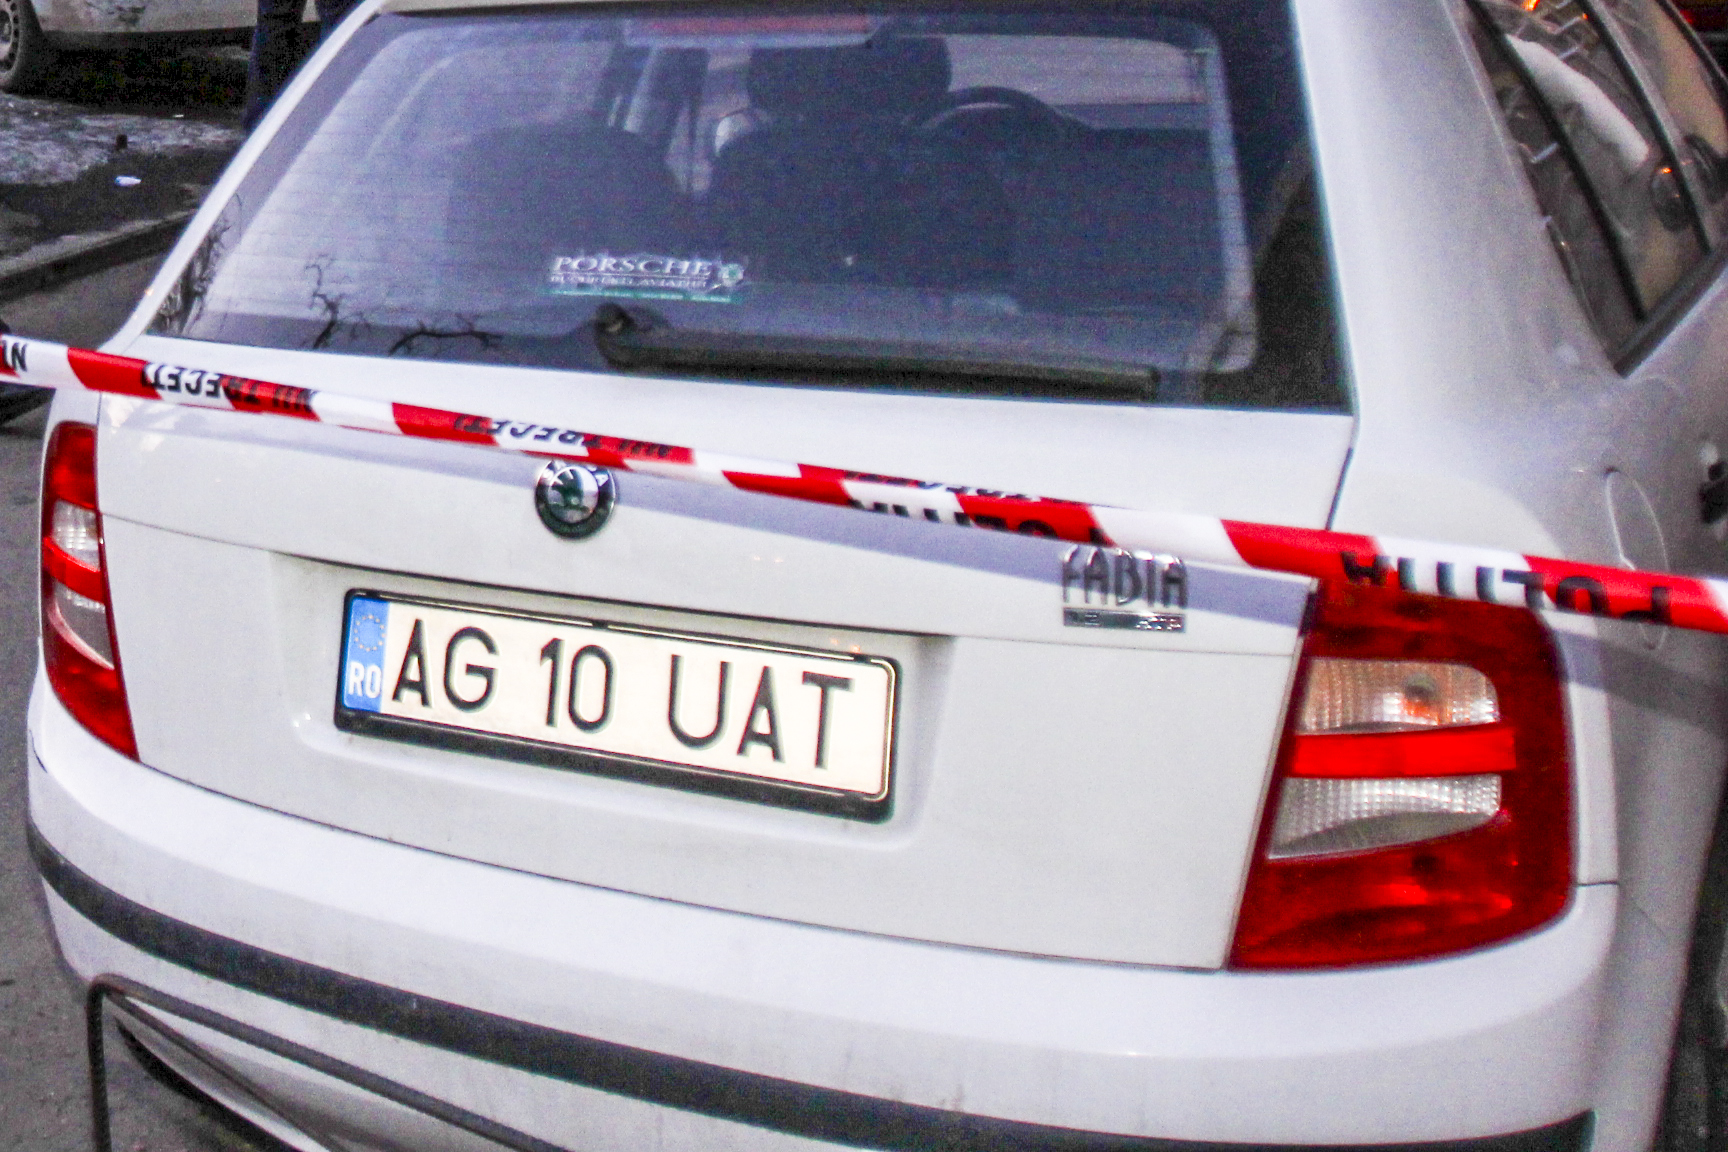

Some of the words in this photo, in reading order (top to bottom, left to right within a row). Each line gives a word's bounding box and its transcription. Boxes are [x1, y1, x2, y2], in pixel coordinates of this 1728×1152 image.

[552, 256, 713, 277] PORSCHE
[1062, 545, 1188, 609] FABIA
[347, 659, 383, 701] RO
[391, 618, 500, 713] AG
[539, 637, 620, 734] 10
[667, 654, 854, 770] UAT
